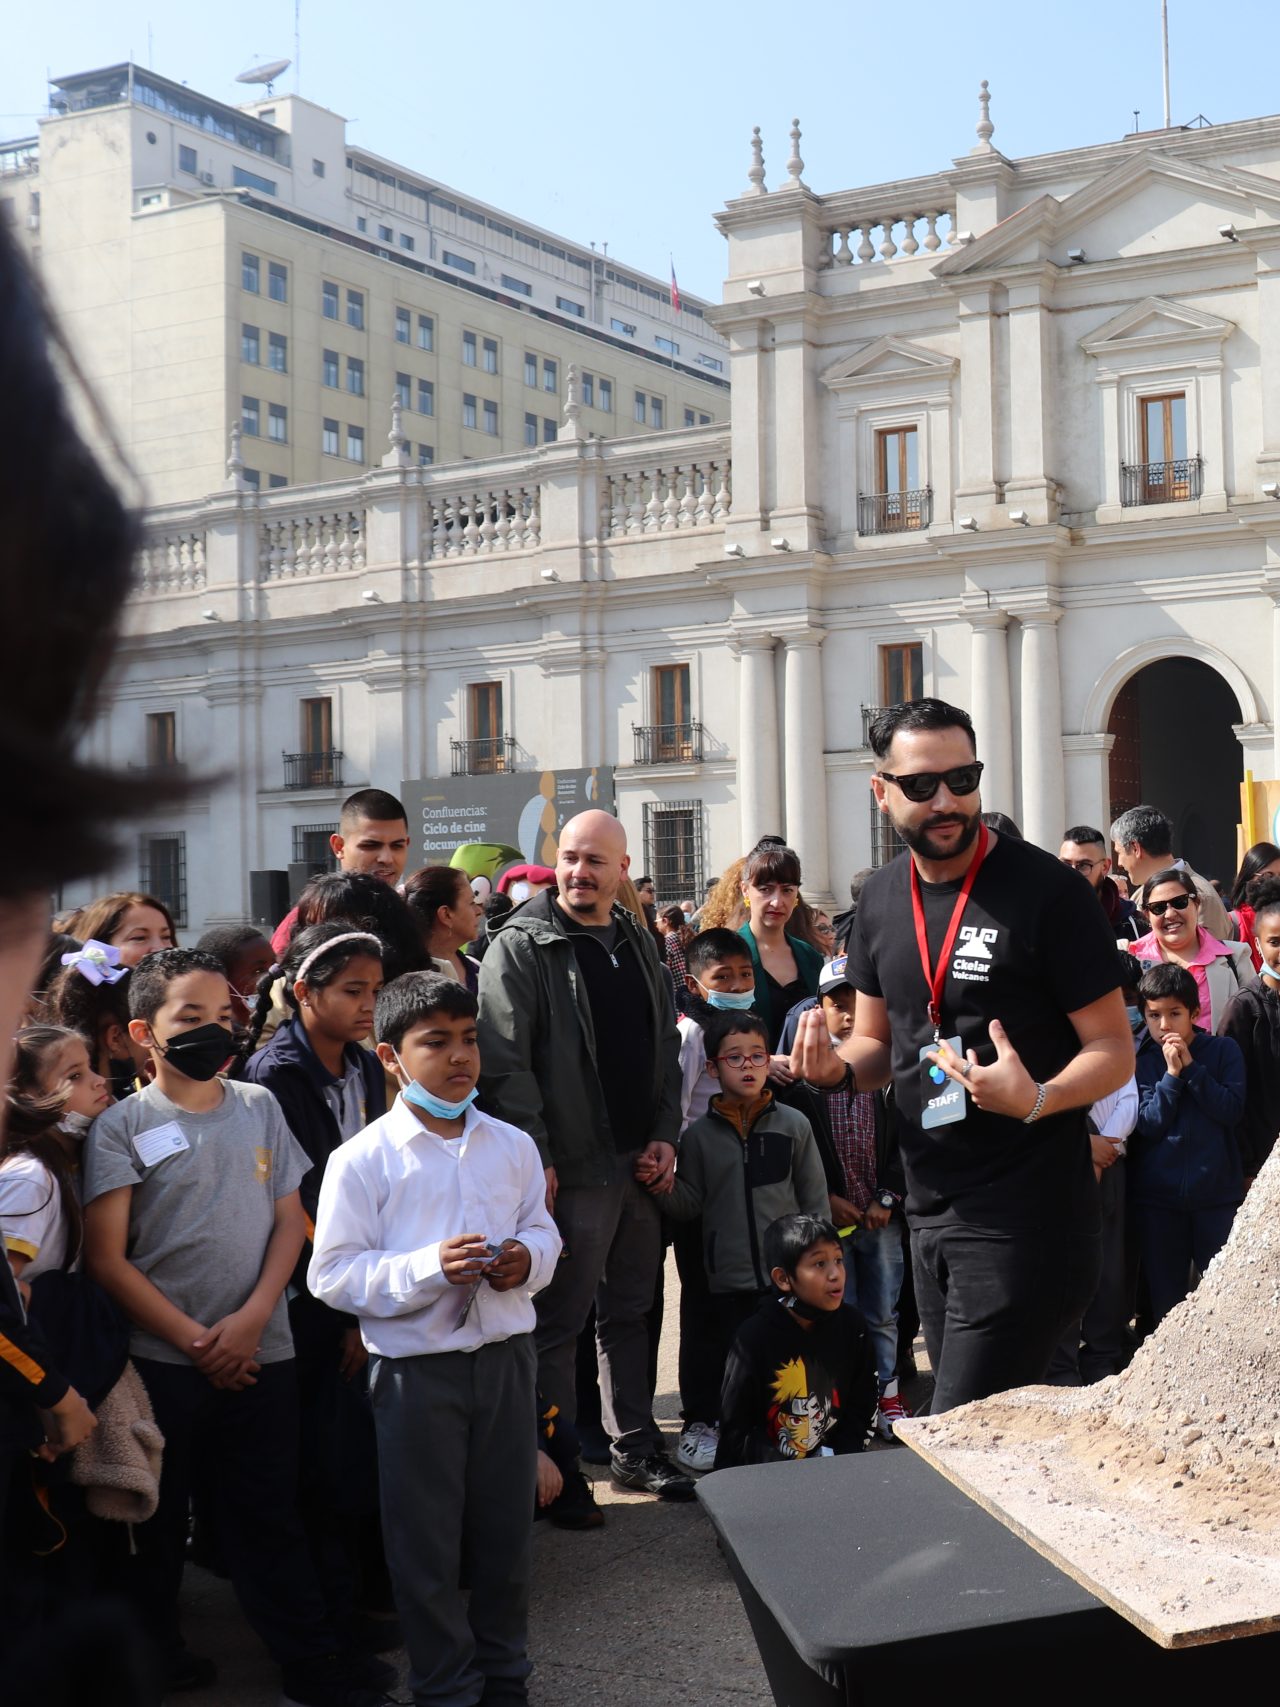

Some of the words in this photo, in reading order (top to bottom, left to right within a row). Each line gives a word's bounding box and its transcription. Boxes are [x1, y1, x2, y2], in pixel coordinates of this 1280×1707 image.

[422, 804, 488, 819] Confluencias:
[422, 822, 449, 835] Ciclo
[450, 821, 463, 834] de
[464, 820, 486, 833] cine
[423, 836, 482, 851] documetl
[953, 959, 991, 973] Ckelar
[952, 970, 990, 982] Volcanes
[927, 1092, 960, 1109] STAFF
